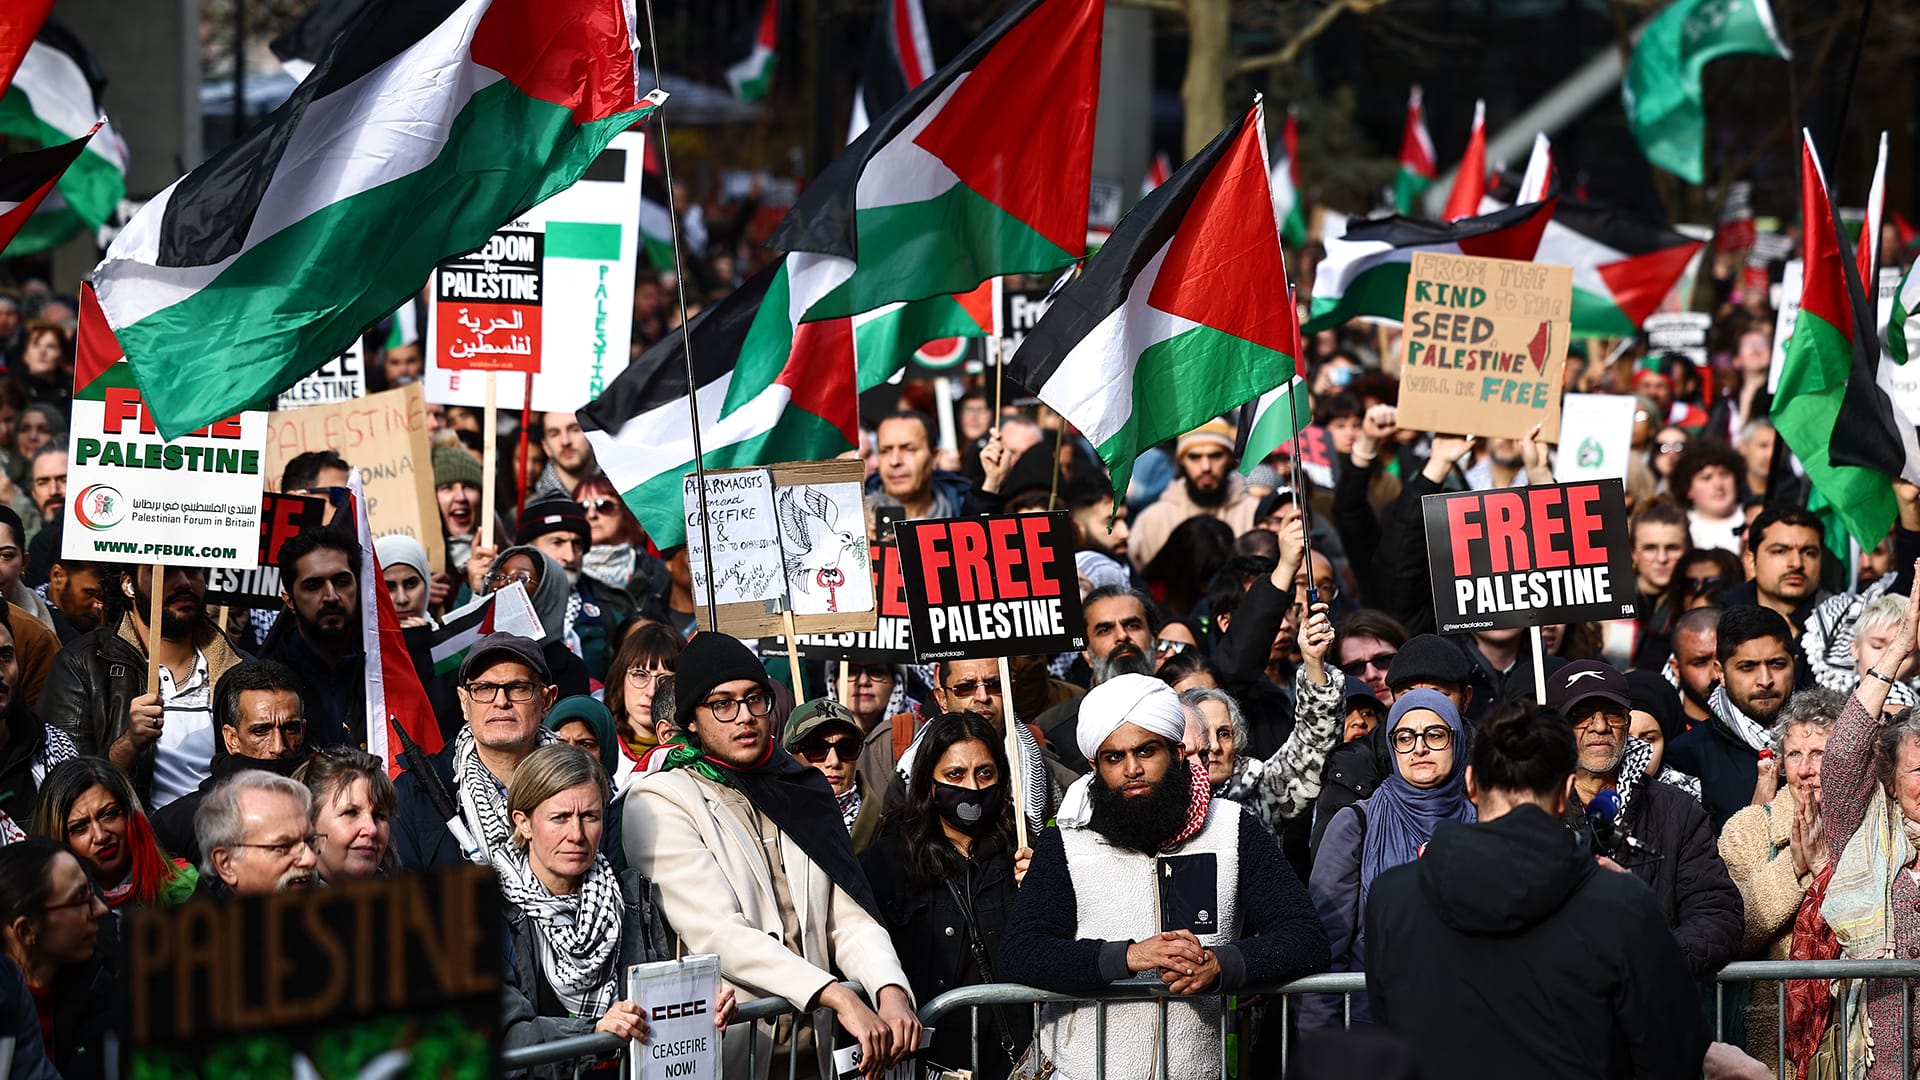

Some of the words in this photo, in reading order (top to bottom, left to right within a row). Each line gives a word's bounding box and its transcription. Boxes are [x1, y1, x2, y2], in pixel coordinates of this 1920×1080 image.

[484, 260, 500, 273] for
[1416, 254, 1487, 284] FROM
[1499, 262, 1549, 290] THE
[442, 272, 539, 300] PALESTINE
[1415, 279, 1486, 309] RIND
[1494, 290, 1516, 312] TO
[458, 308, 523, 335] الحرية
[449, 333, 532, 358] لفلسطين
[1408, 341, 1527, 374] PALESTINE
[1480, 377, 1549, 409] FREE
[76, 438, 260, 475] PALESTINE
[131, 512, 181, 524] Palestinian
[184, 514, 212, 526] Forum
[214, 516, 223, 526] in
[225, 517, 255, 528] Britain
[717, 524, 729, 542] &
[1446, 484, 1608, 576] FREE
[93, 541, 237, 559] WWW.PFBUK.COM
[915, 517, 1061, 604] FREE
[1455, 566, 1612, 615] PALESTINE
[929, 599, 1065, 644] PALESTINE
[652, 1037, 707, 1060] CEASEFIRE
[665, 1060, 697, 1078] NOW!
